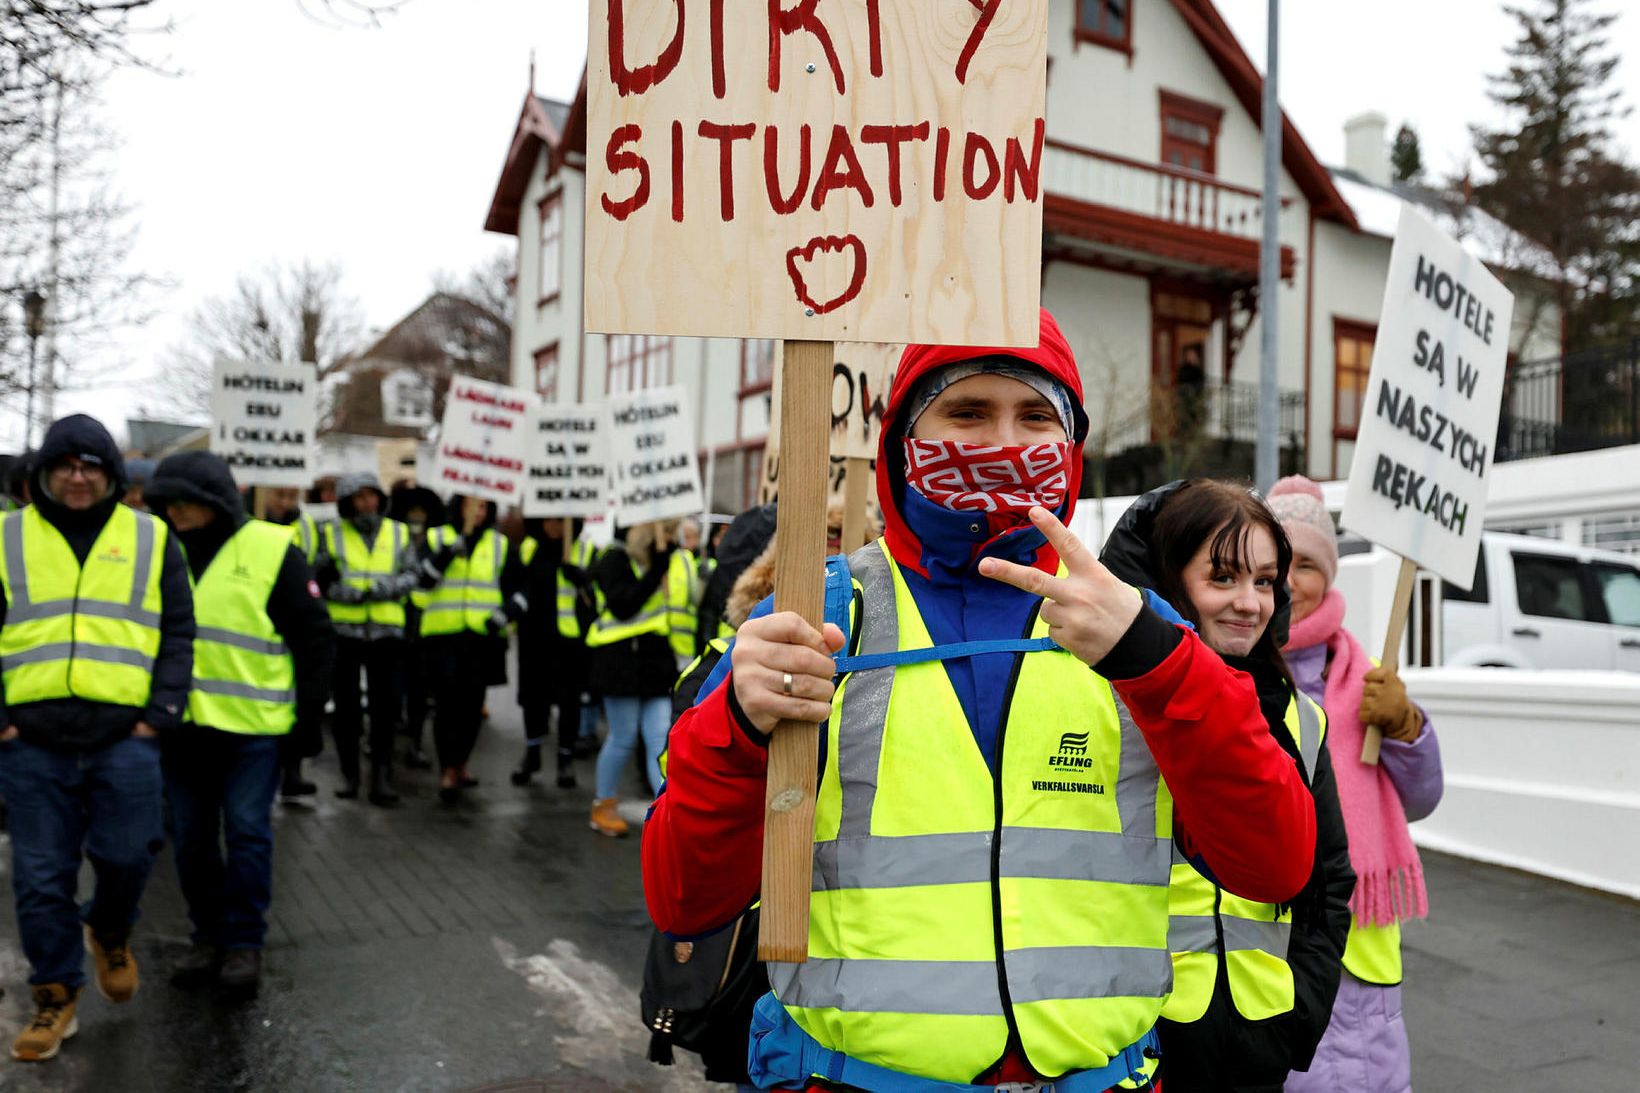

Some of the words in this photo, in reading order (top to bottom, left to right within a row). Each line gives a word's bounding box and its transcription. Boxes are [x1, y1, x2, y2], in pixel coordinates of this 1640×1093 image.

[601, 118, 1045, 222] SITUATION
[1415, 255, 1494, 345] HOTELE
[1413, 329, 1446, 387] SĄ
[1456, 355, 1478, 399] W
[1376, 379, 1486, 477] NASZYCH
[1372, 454, 1468, 536] RĘKACH
[1032, 780, 1104, 795] VERKFALLSVARSLA
[1048, 756, 1093, 768] EFLING
